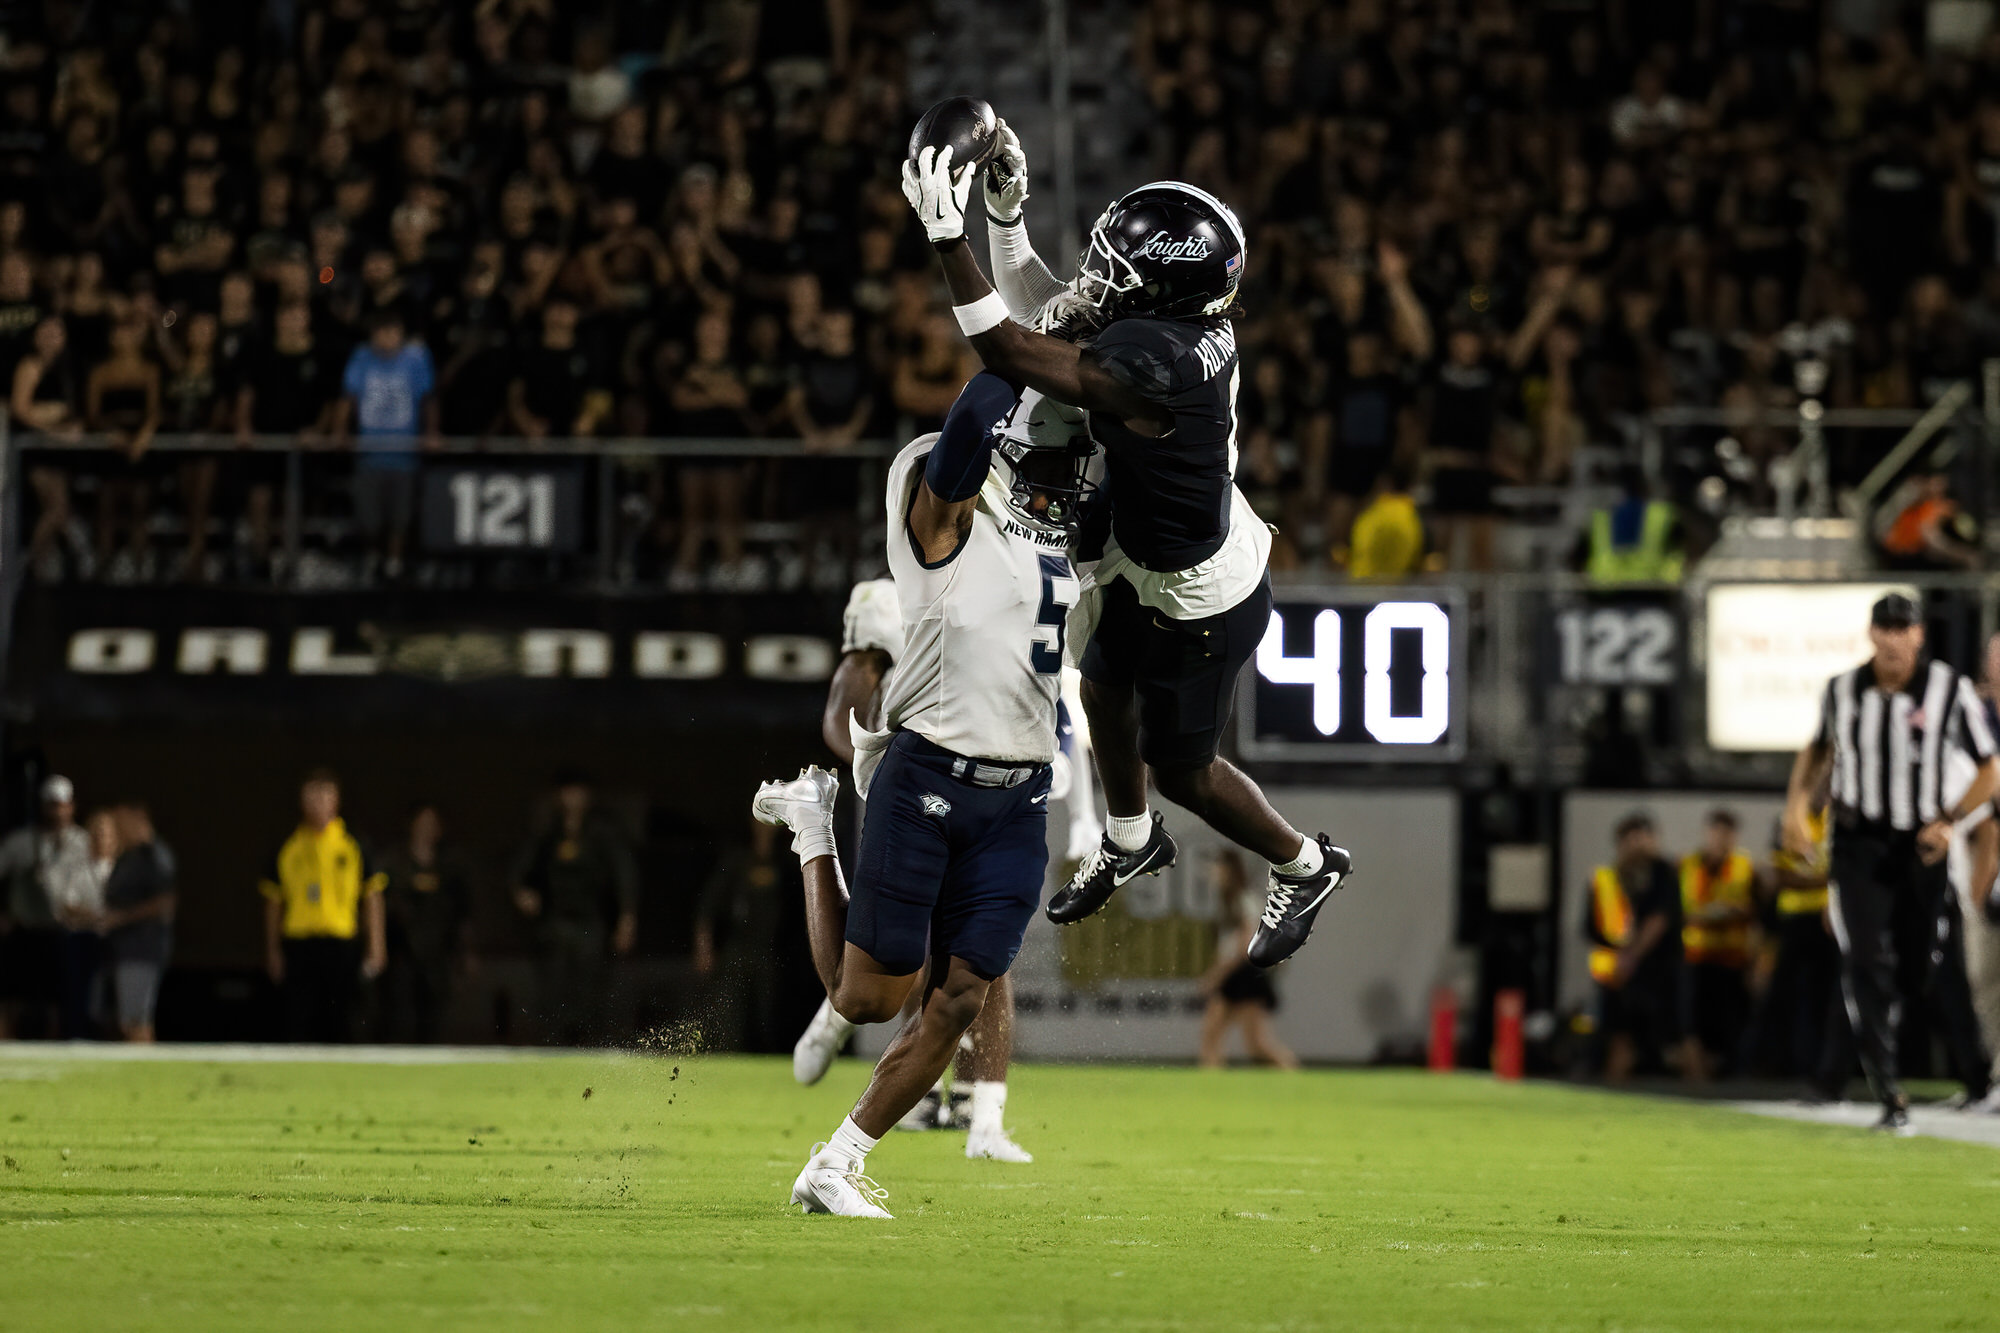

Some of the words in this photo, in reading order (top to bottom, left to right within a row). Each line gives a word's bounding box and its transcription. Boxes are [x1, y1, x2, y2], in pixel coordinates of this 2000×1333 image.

[1129, 230, 1213, 264] Knights
[450, 473, 555, 548] 121
[1003, 519, 1032, 541] NEW
[1028, 551, 1074, 677] 5
[1557, 607, 1676, 686] 122
[65, 626, 836, 682] ORLNDO
[1255, 601, 1450, 744] 40
